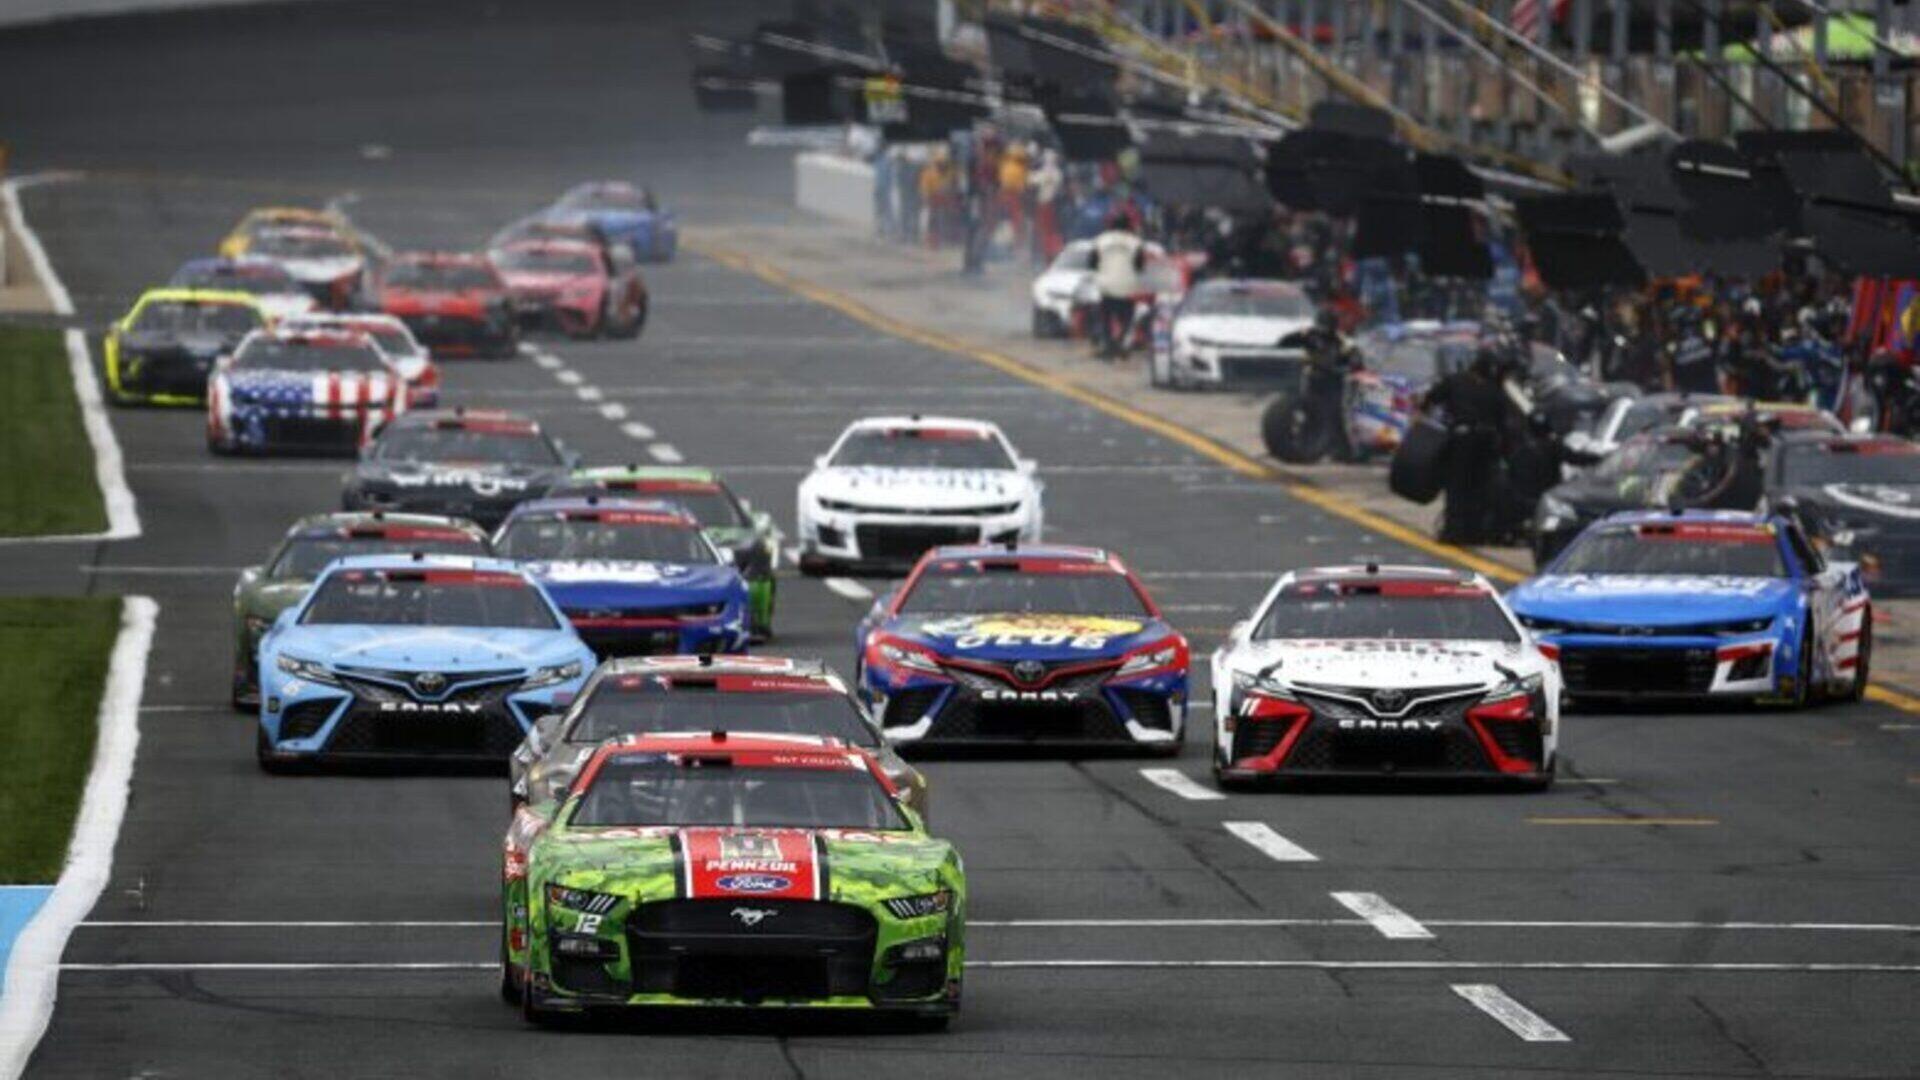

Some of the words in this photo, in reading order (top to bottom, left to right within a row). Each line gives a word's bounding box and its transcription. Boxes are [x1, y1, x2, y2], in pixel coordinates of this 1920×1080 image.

[1339, 719, 1442, 730] CAMRY
[706, 860, 797, 873] PENNZOIL
[731, 875, 776, 890] Ford
[575, 912, 602, 933] 12
